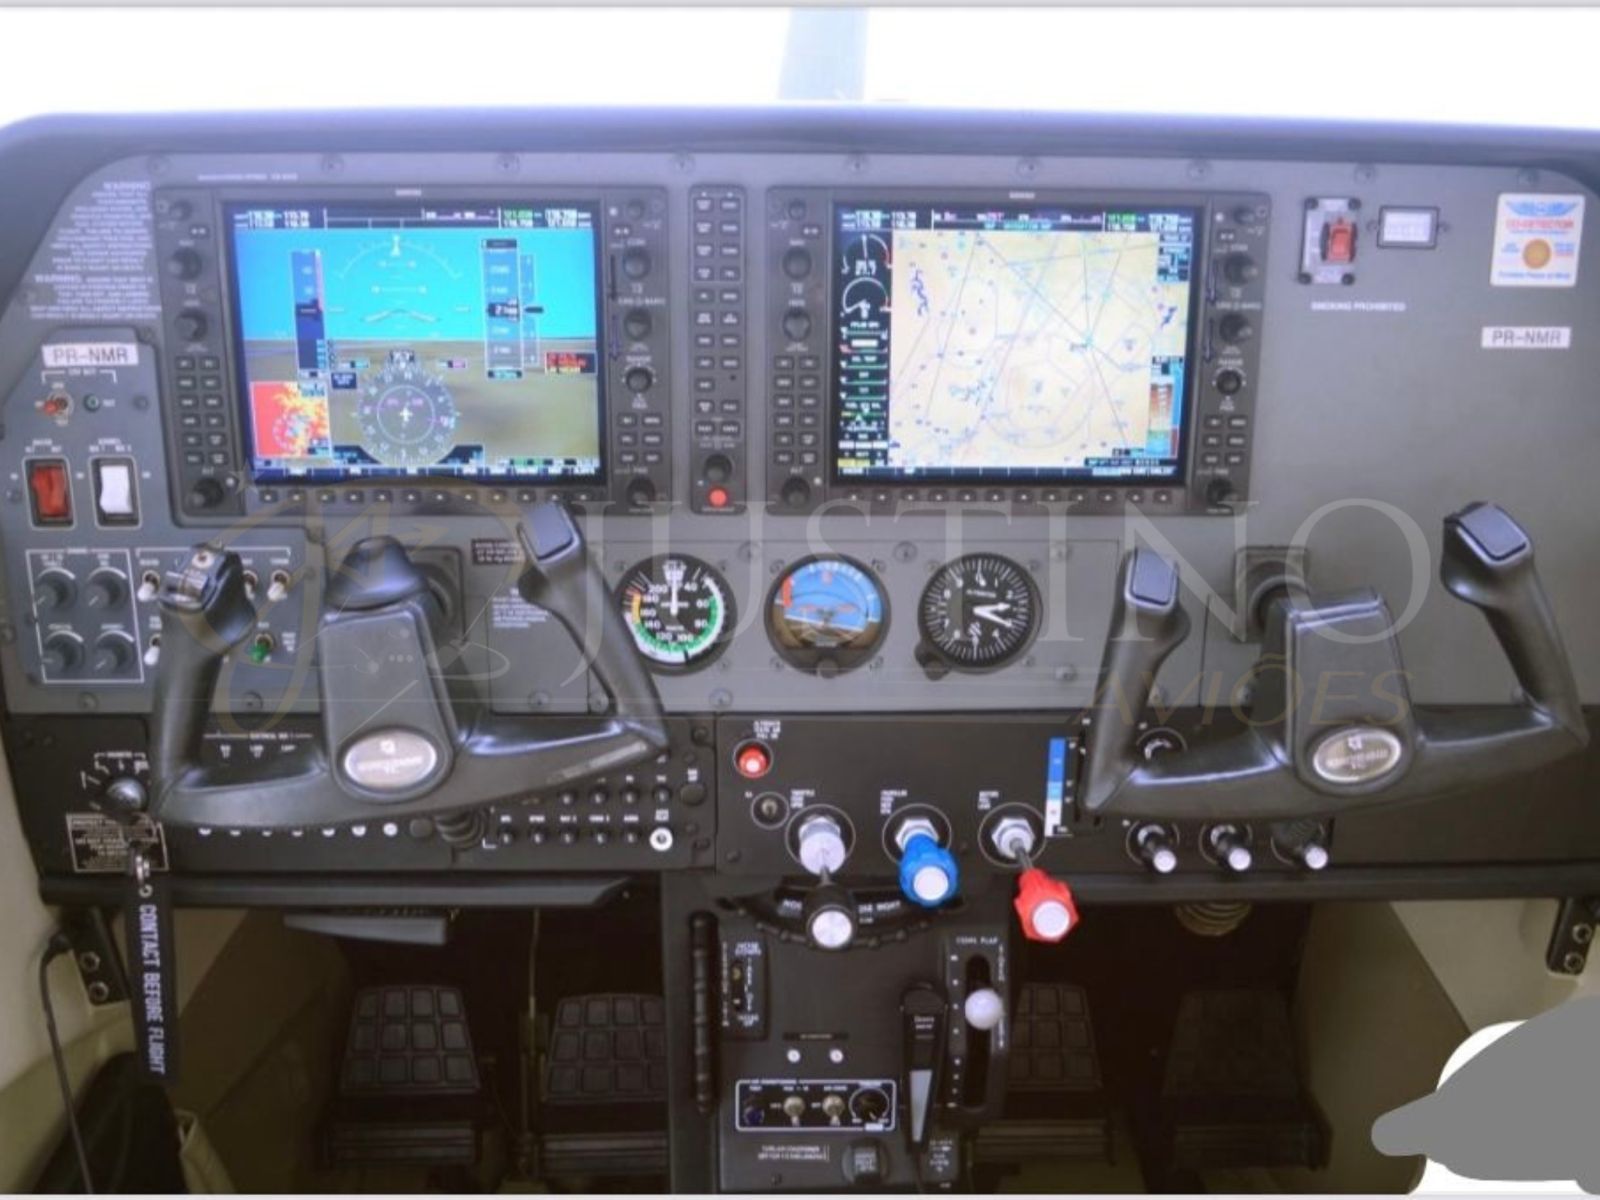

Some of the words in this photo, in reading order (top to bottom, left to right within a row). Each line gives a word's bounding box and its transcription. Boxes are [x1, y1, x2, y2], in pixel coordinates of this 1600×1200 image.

[1311, 301, 1352, 312] SMOKING
[1353, 301, 1406, 313] PROHIBITED
[1492, 329, 1561, 345] PR-NMR
[53, 346, 128, 364] PR-NMR
[139, 904, 160, 966] CONTACT
[143, 972, 164, 1022] BEFORE
[148, 1027, 166, 1075] FLIGHT
